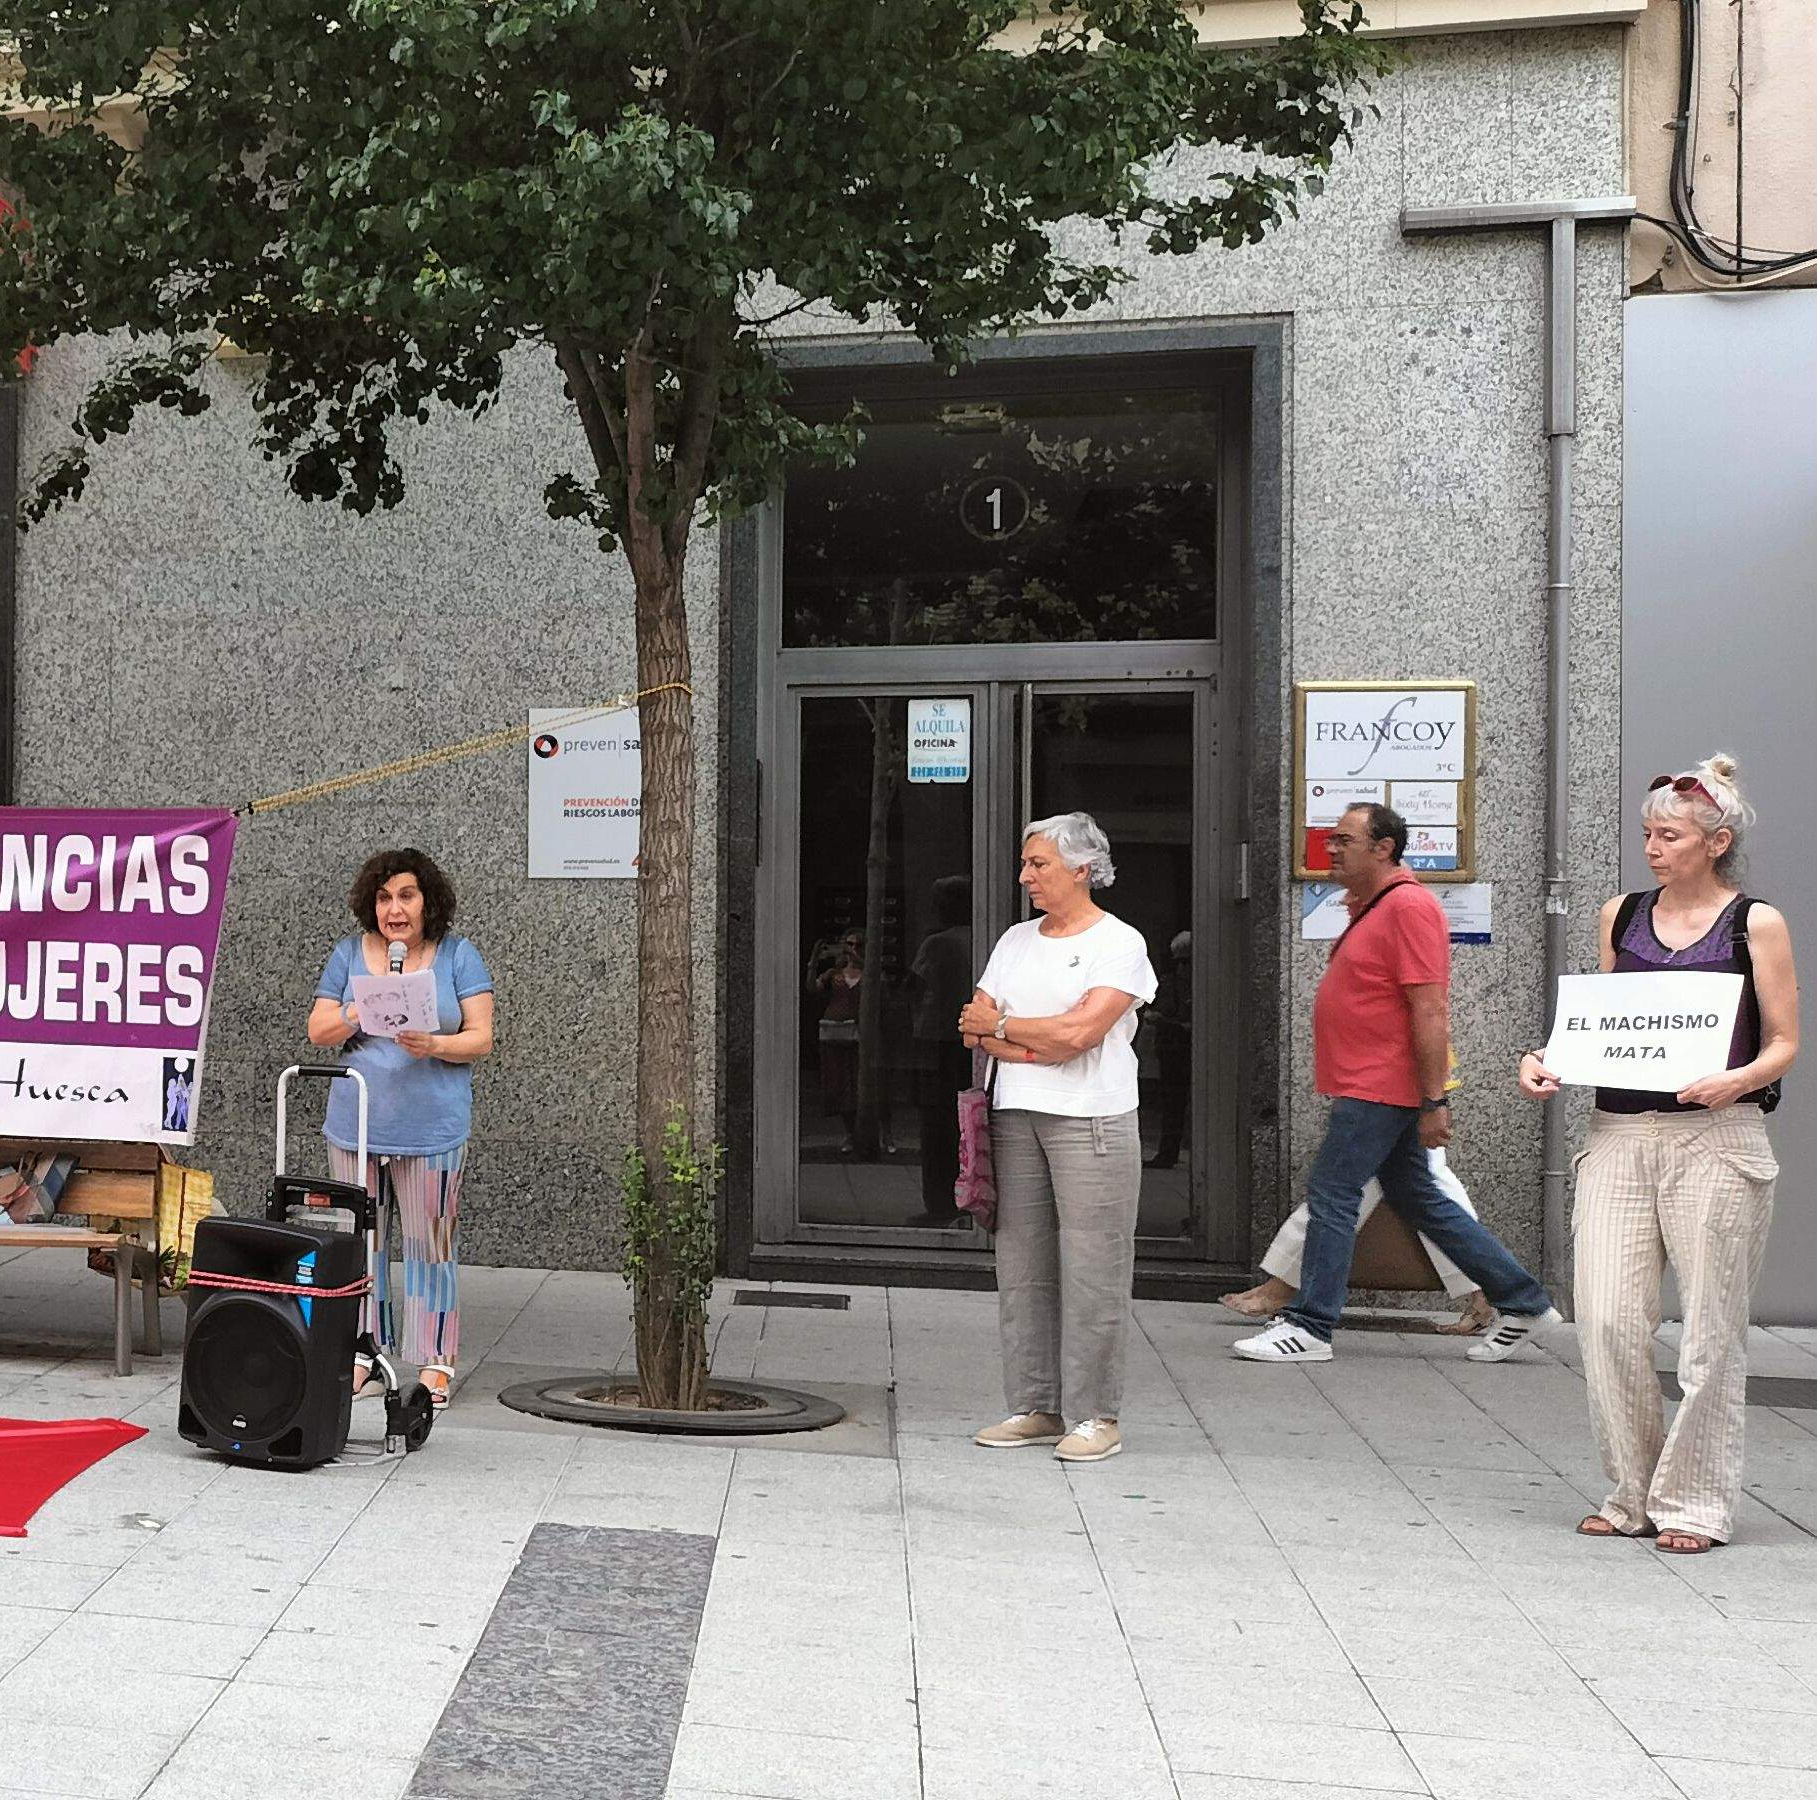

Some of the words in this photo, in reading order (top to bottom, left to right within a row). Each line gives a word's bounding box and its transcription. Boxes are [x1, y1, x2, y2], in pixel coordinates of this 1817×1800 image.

[985, 488, 1001, 529] 1
[932, 703, 947, 717] SE
[914, 720, 965, 735] ALQUILA
[563, 738, 617, 754] preven
[913, 739, 958, 748] OFICINA
[563, 796, 629, 807] PREVENCIÓN
[631, 799, 641, 807] D
[563, 808, 606, 818] RIESGOS
[608, 808, 641, 818] LABOR
[1567, 1017, 1591, 1031] EL
[1599, 1013, 1719, 1031] MACHISMO
[1603, 1046, 1667, 1059] MATA
